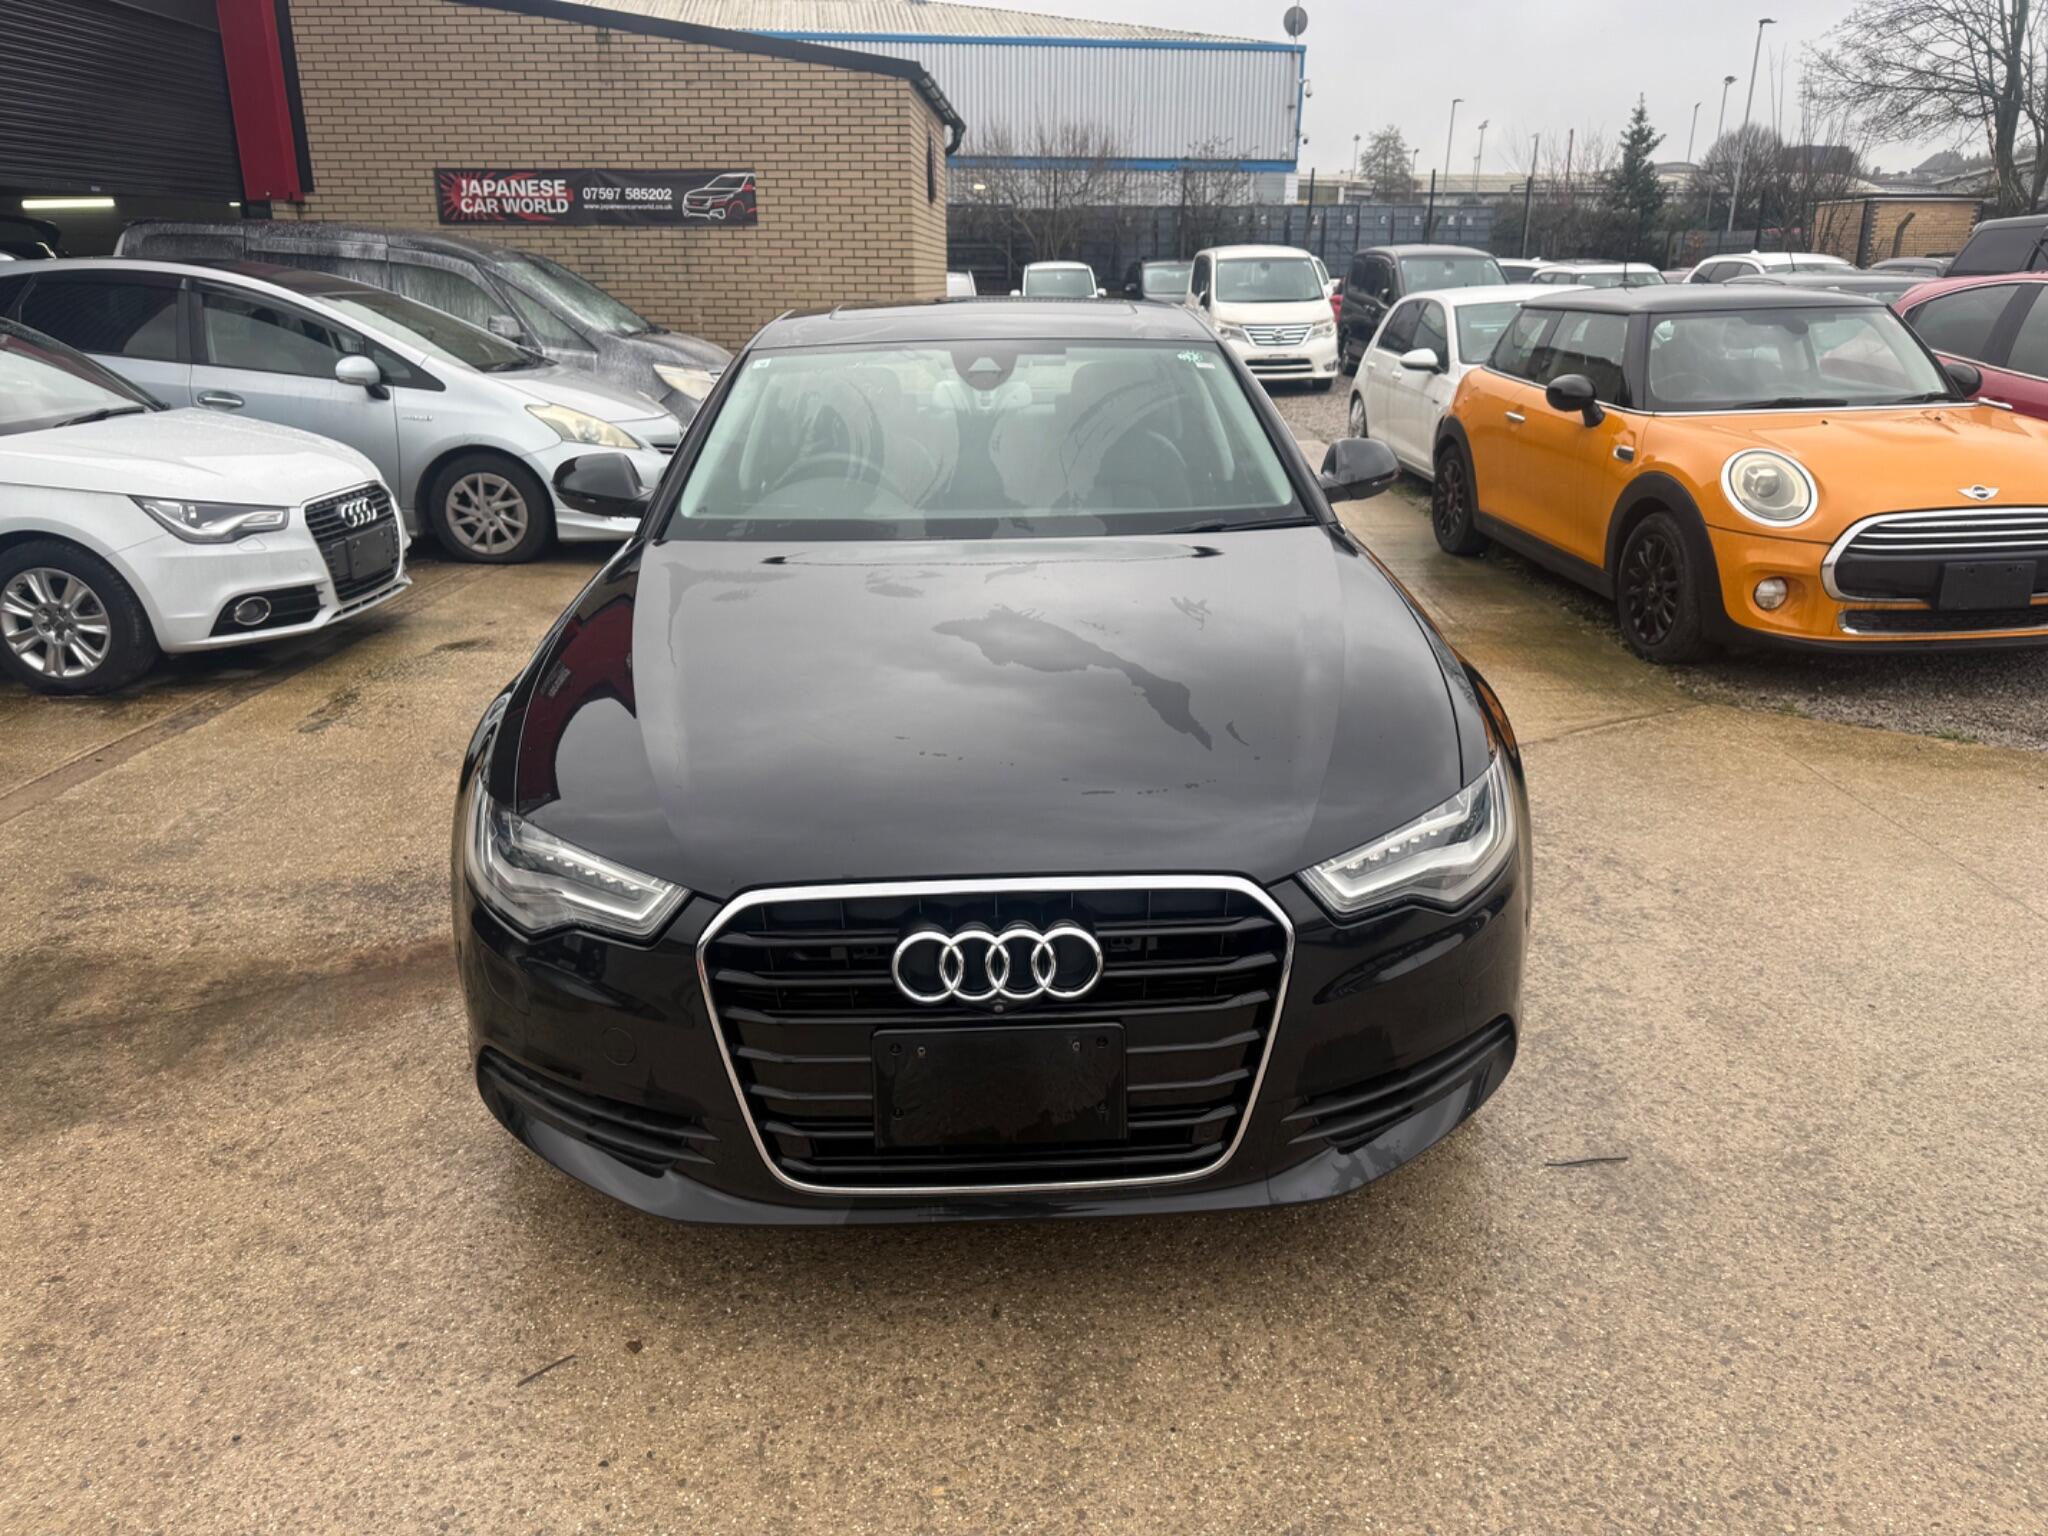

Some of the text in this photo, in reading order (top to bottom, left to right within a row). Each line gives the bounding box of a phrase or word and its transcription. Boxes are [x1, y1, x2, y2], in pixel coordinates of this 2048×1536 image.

[460, 179, 567, 197] JAPANESE
[582, 187, 673, 201] 07597 585202
[460, 198, 569, 214] CAR WORLD
